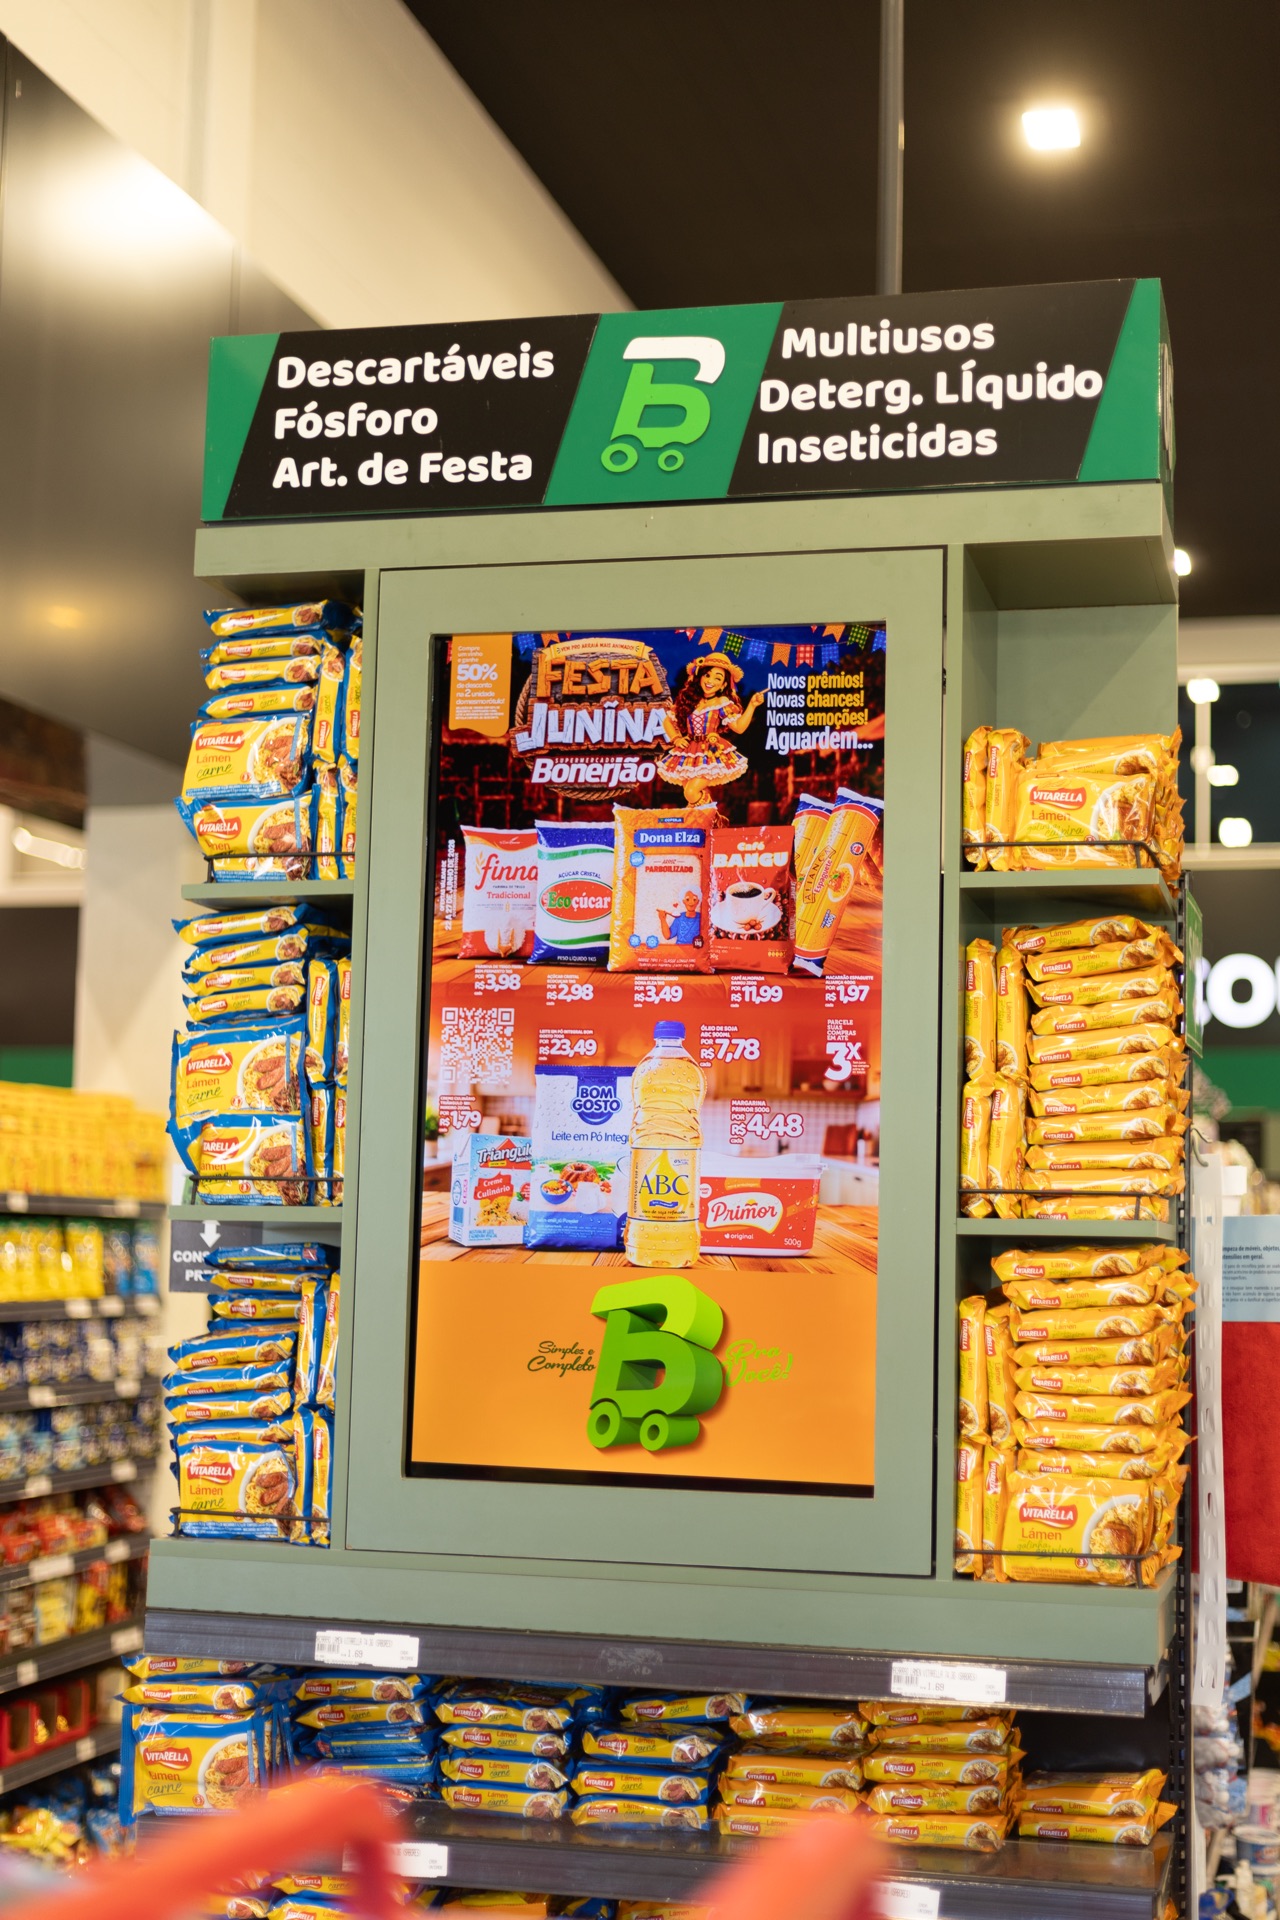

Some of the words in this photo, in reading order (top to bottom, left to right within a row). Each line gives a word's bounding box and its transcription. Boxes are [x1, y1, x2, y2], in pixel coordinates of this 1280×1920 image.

[782, 321, 995, 359] Multiusos
[277, 342, 555, 390] Descartáveis
[759, 375, 923, 414] Deterg.
[935, 348, 1103, 406] Líquido
[274, 402, 439, 440] Fósforo
[758, 425, 997, 463] Inseticidas
[273, 453, 348, 489] Art.
[357, 450, 408, 486] de
[420, 449, 532, 483] Festa
[457, 664, 498, 681] 50%
[536, 653, 664, 698] FESTA
[768, 673, 806, 689] Novos
[807, 671, 864, 692] prêmios!
[767, 692, 805, 708] Novas
[806, 690, 864, 707] chances!
[515, 700, 671, 752] JUNINA
[766, 710, 805, 726] Novas
[806, 709, 868, 730] emoções!
[198, 735, 242, 746] VITARELLA
[765, 726, 873, 755] Aguardem...
[196, 754, 231, 763] Lámen
[196, 764, 232, 778] carne
[531, 757, 655, 787] Bonerjão
[1033, 791, 1082, 802] VITARELLA
[1032, 810, 1071, 821] Lámen
[199, 820, 238, 833] VITARELLA
[640, 832, 673, 844] Dona
[675, 832, 700, 844] Elza
[737, 841, 765, 851] Café
[714, 852, 789, 868] BANGU
[446, 868, 454, 893] JUNHO
[580, 871, 601, 879] CRISTAL
[814, 859, 832, 894] Espaguete
[548, 891, 611, 911] Ecoçúcar
[1043, 963, 1072, 973] VITARELLA
[188, 1058, 231, 1071] VITARELLA
[186, 1077, 220, 1089] Lámen
[1051, 1076, 1081, 1084] VITARELLA
[187, 1087, 221, 1104] carne
[581, 1087, 613, 1099] BOM
[572, 1099, 620, 1112] GOSTO
[551, 1131, 571, 1141] Leite
[573, 1132, 589, 1141] em
[590, 1131, 603, 1141] Pó
[203, 1142, 238, 1151] TARELLA
[483, 1177, 503, 1187] Creme
[639, 1174, 689, 1195] ABC
[477, 1185, 510, 1199] Culinário
[711, 1202, 777, 1222] Primor
[784, 1238, 801, 1247] 500g
[1016, 1267, 1043, 1276] VITARELLA
[1051, 1261, 1073, 1269] Lámen
[1066, 1291, 1089, 1299] Lámen
[1031, 1298, 1059, 1306] VITARELLA
[1018, 1329, 1047, 1338] VITARELLA
[538, 1341, 585, 1359] Simples
[725, 1339, 782, 1364] Pra
[1039, 1354, 1068, 1362] VITARELLA
[527, 1356, 596, 1377] Completo
[722, 1352, 793, 1387] Você!
[190, 1466, 232, 1476] VITARELLA
[190, 1485, 223, 1496] Lámen
[191, 1498, 224, 1510] carne
[1023, 1508, 1074, 1520] VITARELLA
[1021, 1527, 1062, 1540] Lámen
[146, 1751, 189, 1763] VITARELLA
[886, 1765, 914, 1773] VITARELLA
[147, 1782, 183, 1794] carne
[454, 1793, 480, 1802] VITARELLA
[1039, 1829, 1068, 1837] VITARELLA
